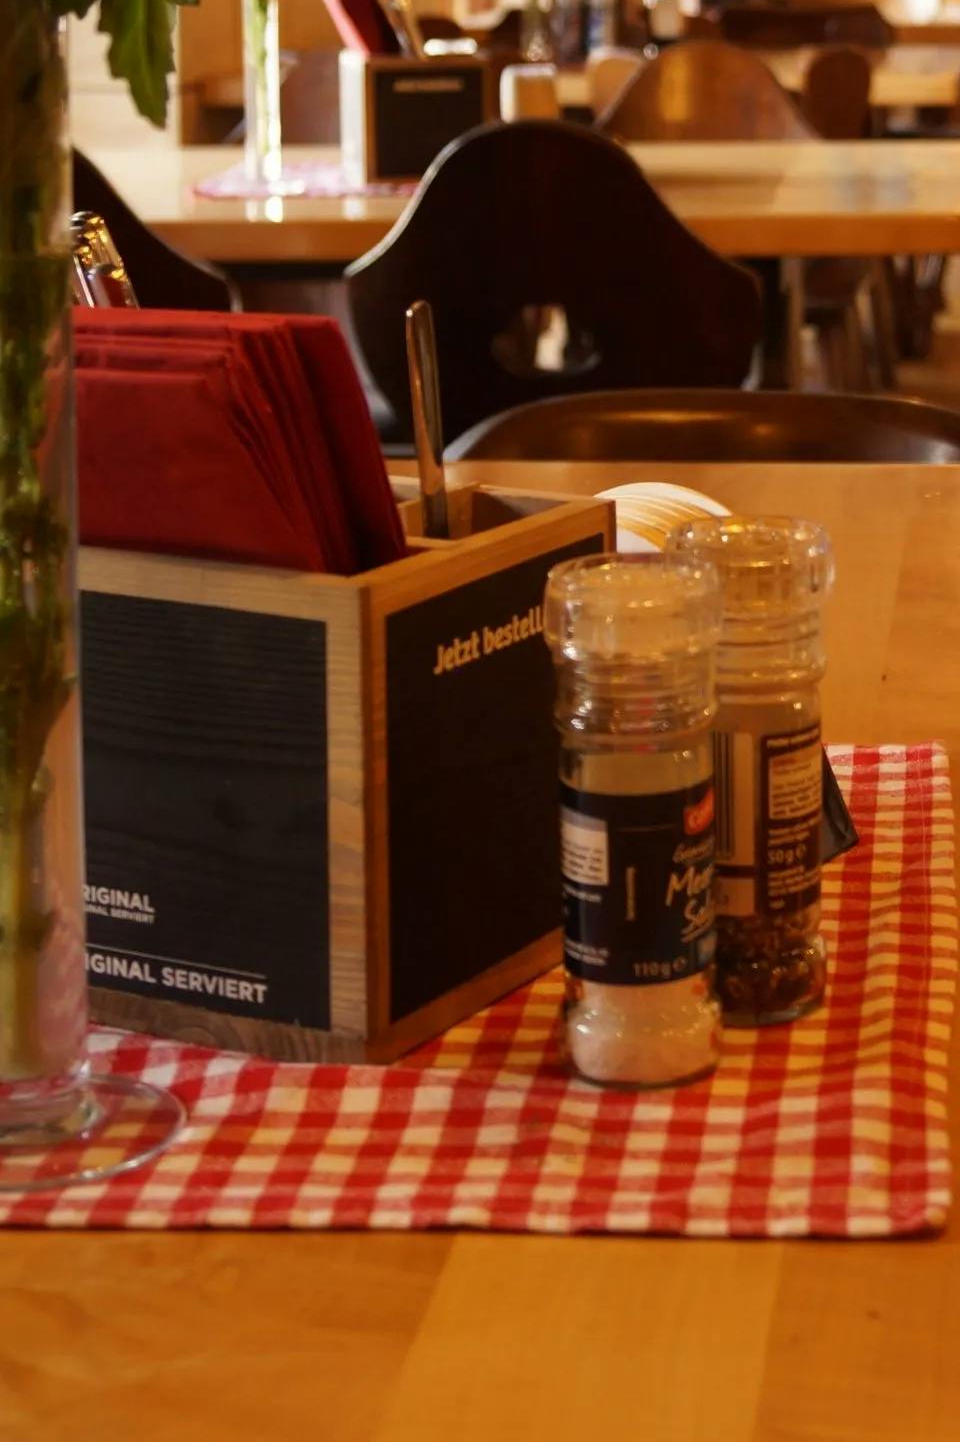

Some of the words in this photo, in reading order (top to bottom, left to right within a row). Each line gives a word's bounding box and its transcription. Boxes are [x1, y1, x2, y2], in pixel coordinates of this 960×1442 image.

[433, 631, 480, 675] Jetzt
[482, 605, 543, 655] bestell
[81, 884, 155, 913] RIGINAL
[84, 953, 156, 984] IGINAL
[161, 967, 268, 1004] SERVIERT
